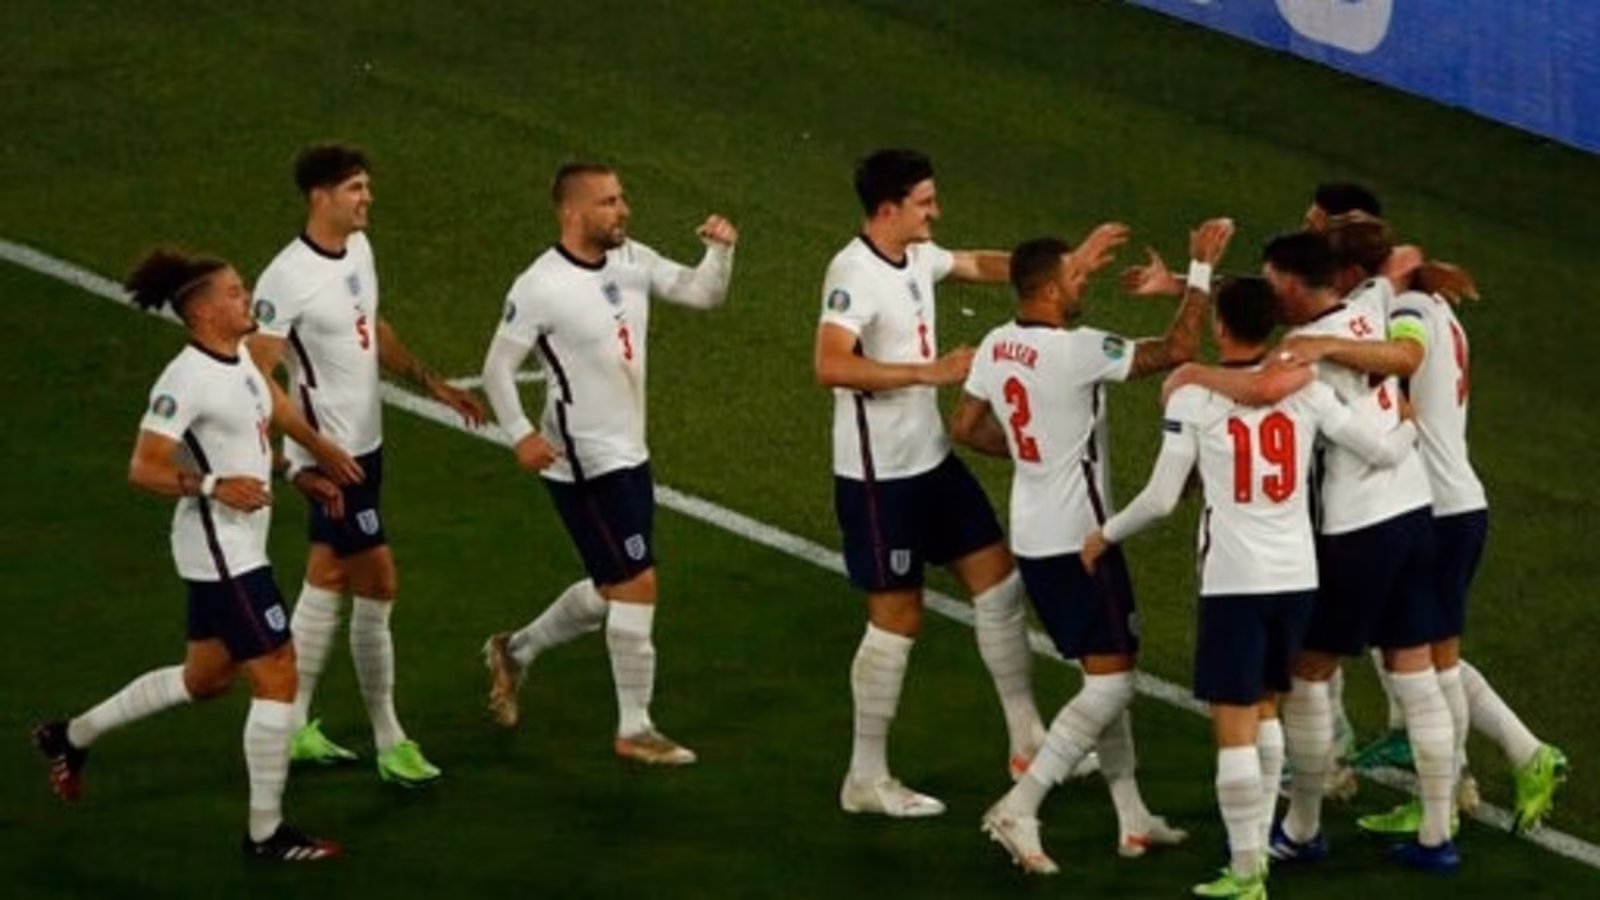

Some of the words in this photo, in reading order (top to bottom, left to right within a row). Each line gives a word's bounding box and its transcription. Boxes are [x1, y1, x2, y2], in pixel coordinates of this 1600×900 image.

[618, 327, 633, 361] 3
[1004, 376, 1042, 463] 2
[1227, 410, 1298, 504] 19
